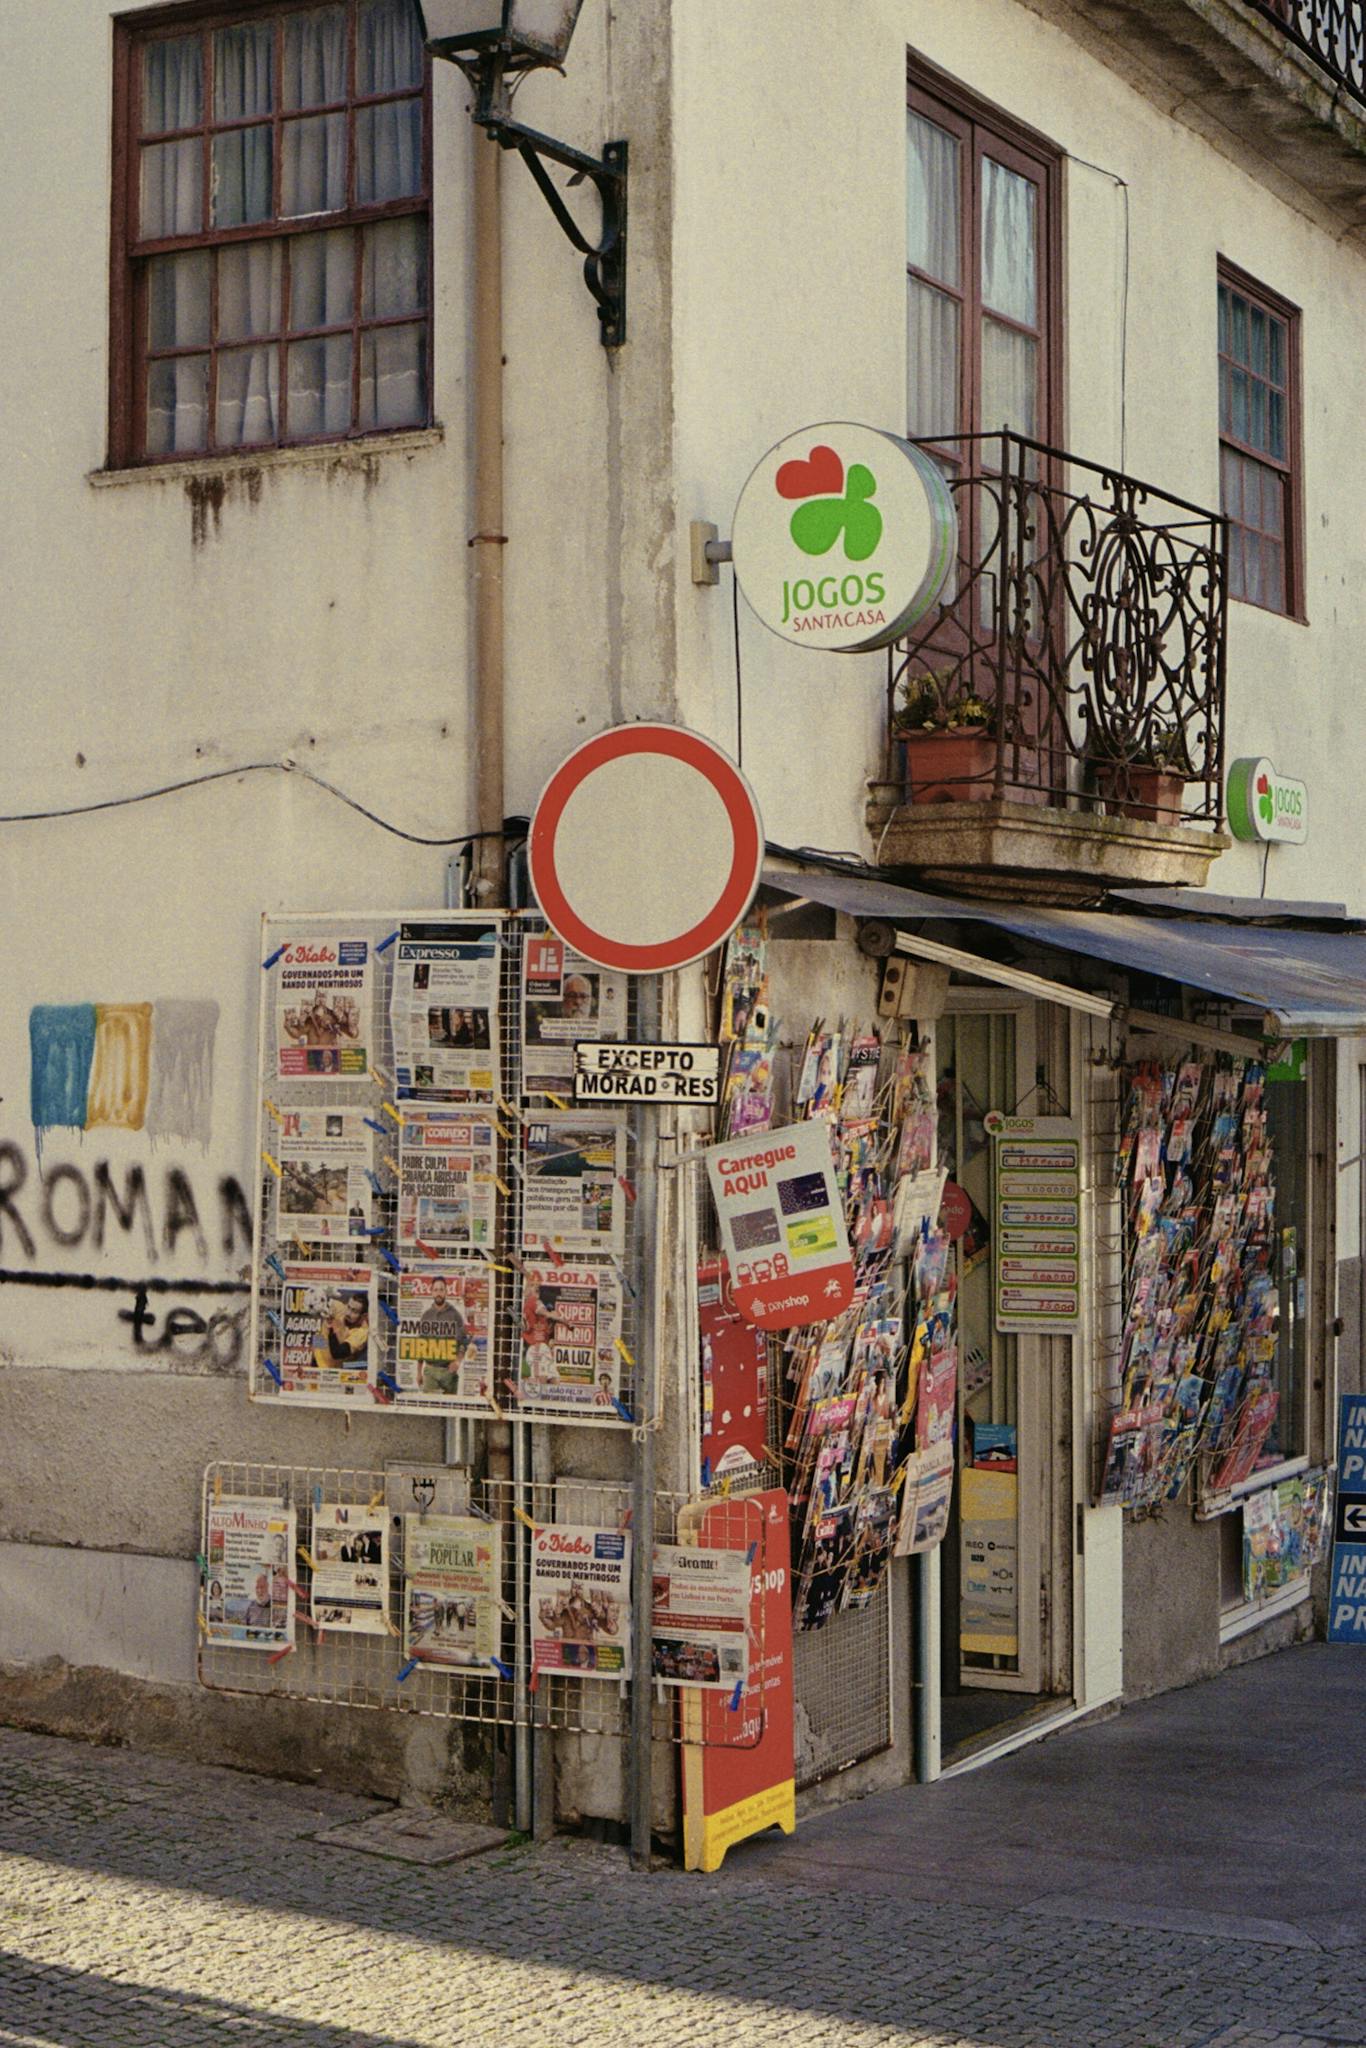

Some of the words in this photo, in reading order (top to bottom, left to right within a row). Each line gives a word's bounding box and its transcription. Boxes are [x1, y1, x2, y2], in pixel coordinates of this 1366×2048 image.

[781, 572, 886, 624] JOGOS
[400, 945, 460, 961] Expresso
[282, 969, 332, 980] GOVERNADOS
[333, 969, 350, 979] POR
[351, 969, 364, 978] UM
[282, 980, 306, 989] BANDO
[307, 980, 316, 988] DE
[317, 979, 363, 988] MENTIROSOS
[598, 1049, 694, 1070] EXCEPTO
[582, 1074, 714, 1097] MORADRES
[529, 1125, 547, 1142] JN
[402, 1156, 423, 1170] PADRE
[425, 1156, 447, 1170] CULPA
[718, 1145, 796, 1176] Carregue
[402, 1169, 432, 1183] CRIANÇA
[434, 1170, 468, 1184] ABUSADA
[723, 1171, 768, 1197] AQUI
[401, 1183, 418, 1197] POR
[417, 1183, 456, 1197] SACERDOTE
[545, 1271, 597, 1285] BOLA
[768, 1294, 810, 1312] payshop
[558, 1305, 593, 1322] SUPER
[286, 1317, 321, 1333] AGARRA
[401, 1320, 456, 1336] AMORIM
[285, 1333, 304, 1347] QUE
[303, 1331, 312, 1347] É
[557, 1325, 592, 1343] MARIO
[400, 1337, 457, 1360] FIRME
[556, 1348, 570, 1364] DA
[572, 1349, 591, 1365] LUZ
[549, 1534, 592, 1555] Diabo
[430, 1549, 475, 1567] POPULAR
[536, 1559, 588, 1572] GOVERNADOS
[589, 1563, 606, 1572] POR
[607, 1564, 621, 1573] UM
[536, 1569, 560, 1579] BANDO
[561, 1571, 572, 1579] DE
[573, 1571, 621, 1584] MENTIROSOS
